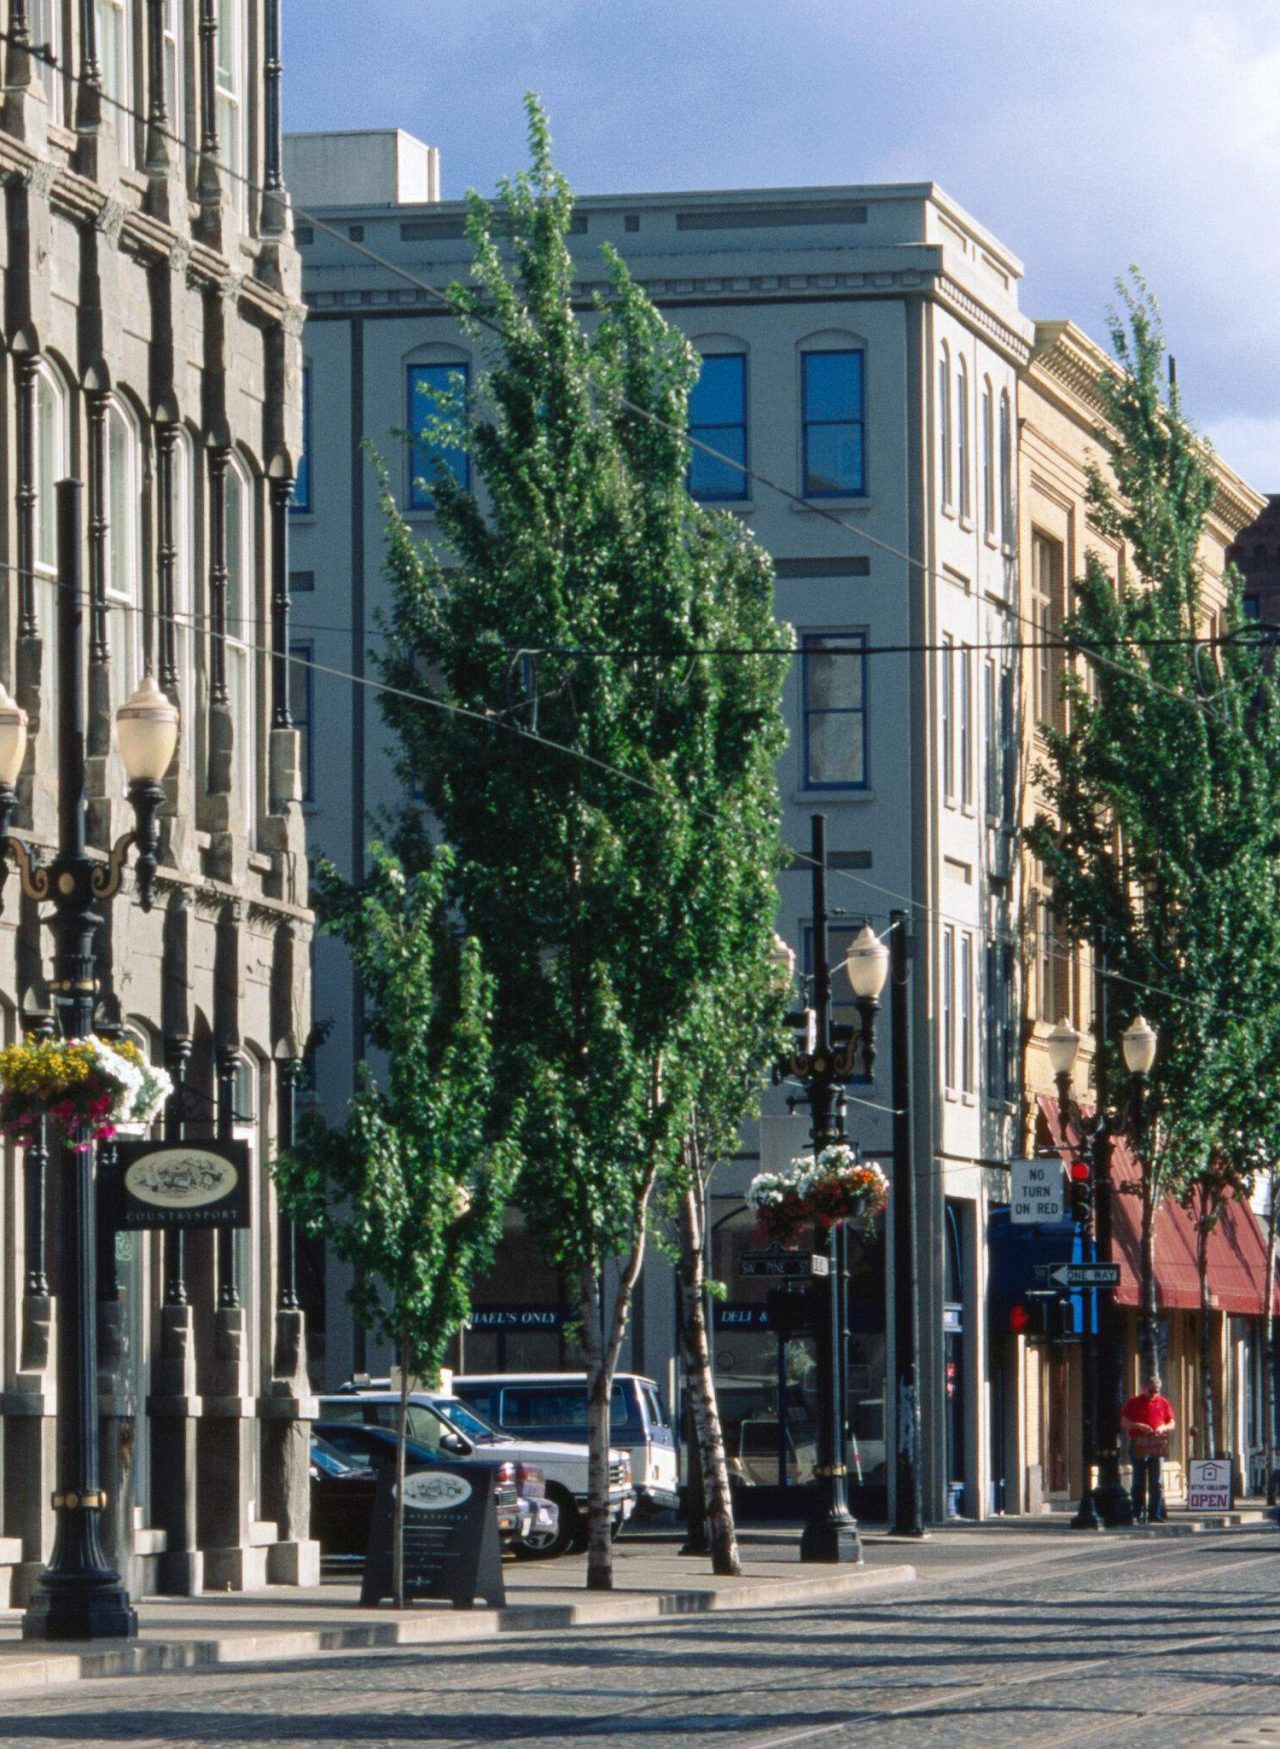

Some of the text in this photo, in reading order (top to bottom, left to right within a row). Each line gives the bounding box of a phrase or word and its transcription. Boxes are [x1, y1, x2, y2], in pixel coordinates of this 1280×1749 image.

[1029, 1170, 1045, 1180] NO
[1022, 1187, 1051, 1198] TURN
[1016, 1204, 1058, 1214] ON RED
[126, 1210, 238, 1221] COUNTRYSPORT
[1067, 1269, 1116, 1281] ONE WAY
[470, 1312, 556, 1323] HAEL'S ONLY
[721, 1311, 752, 1322] DELI
[1191, 1494, 1228, 1507] OPEN
